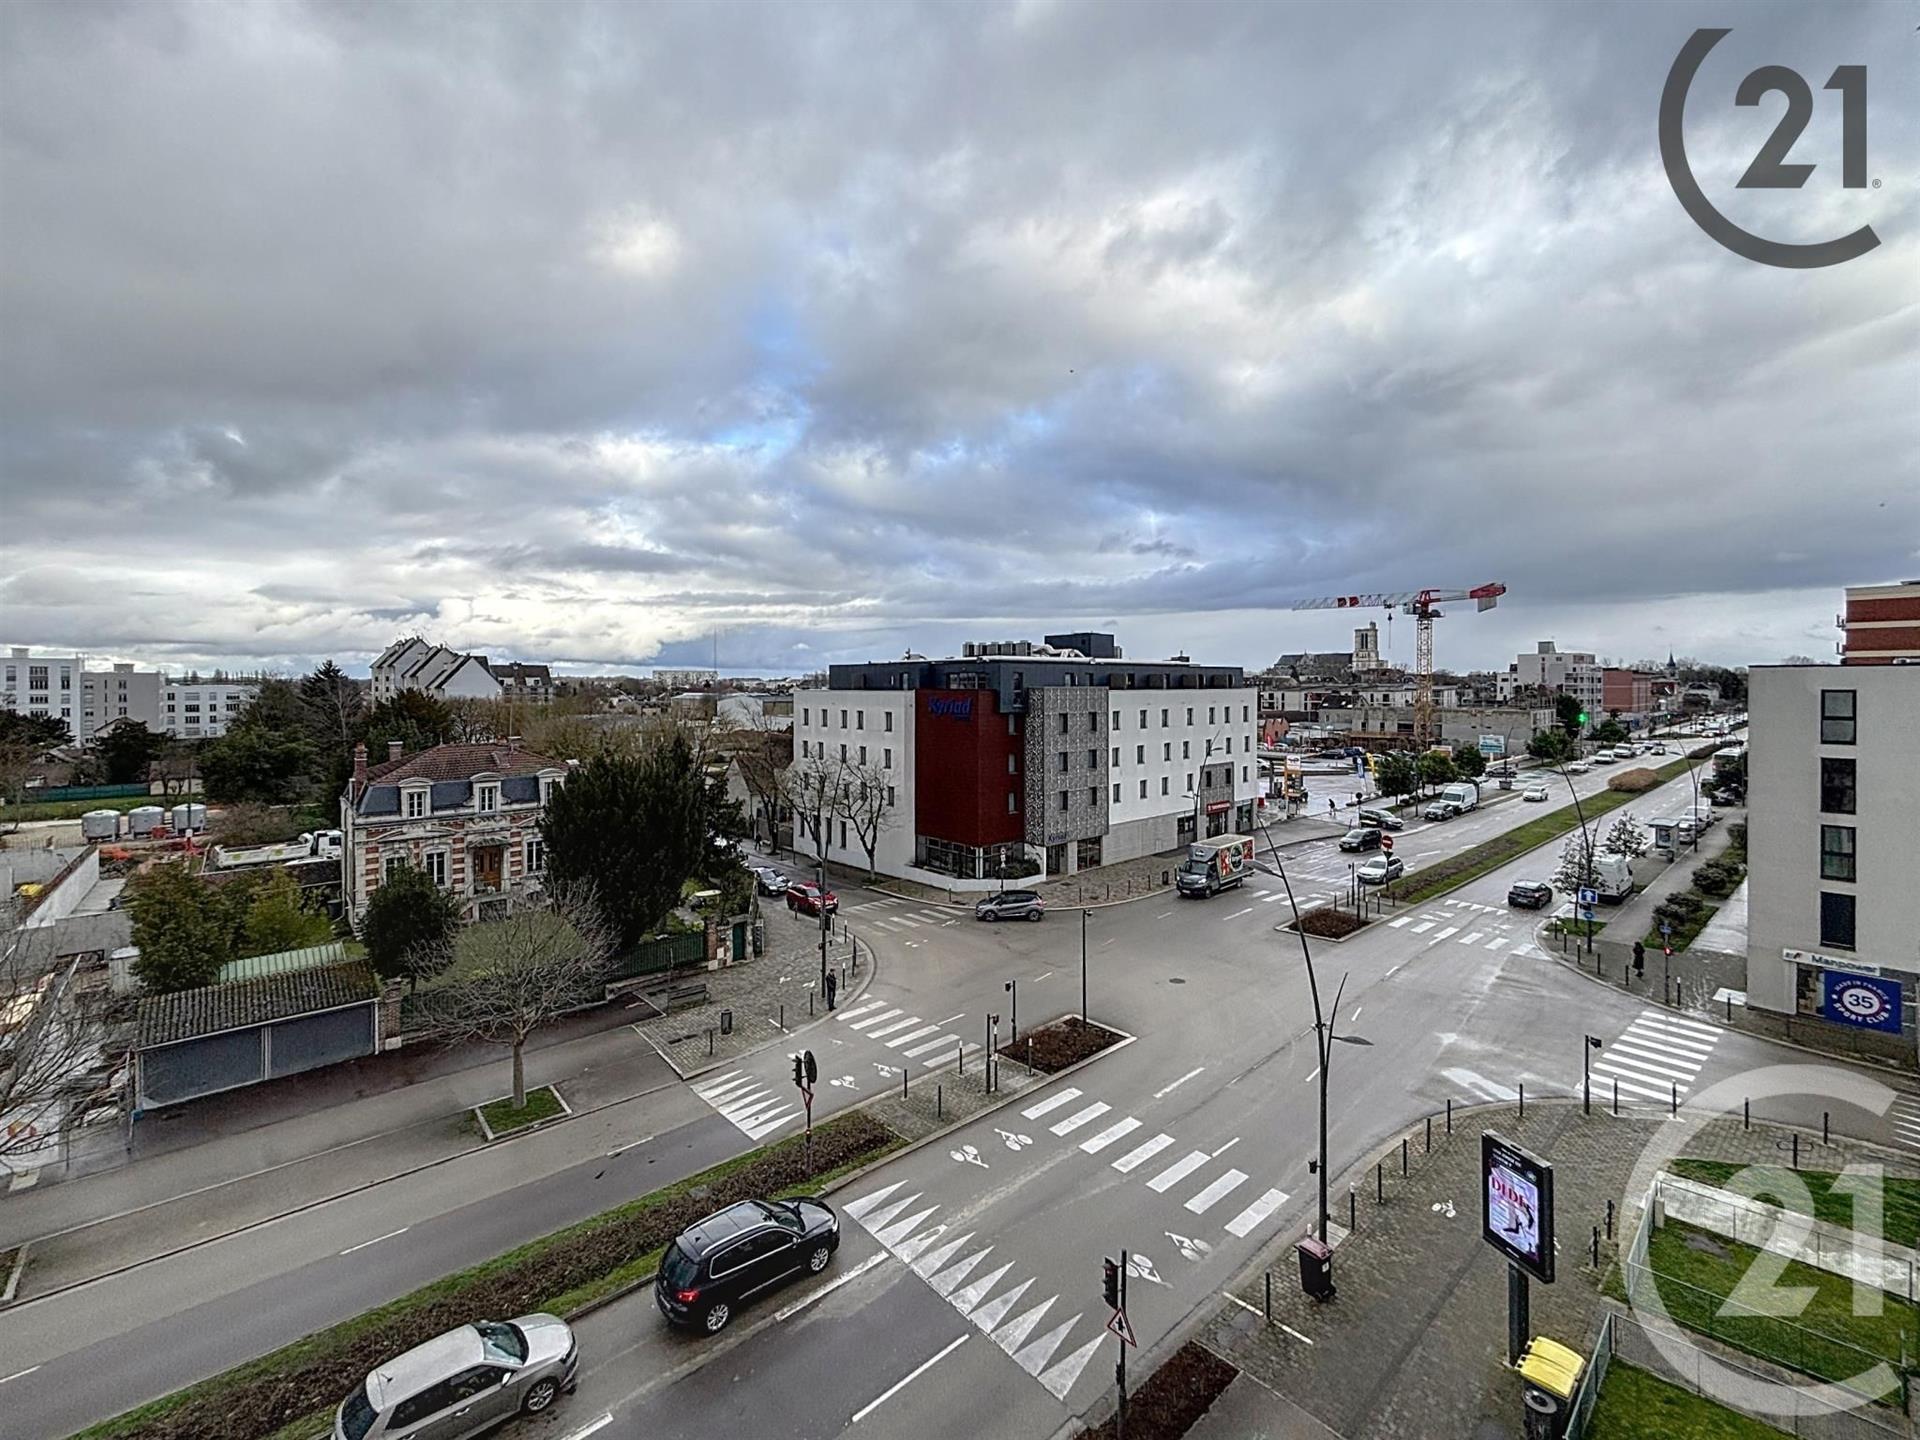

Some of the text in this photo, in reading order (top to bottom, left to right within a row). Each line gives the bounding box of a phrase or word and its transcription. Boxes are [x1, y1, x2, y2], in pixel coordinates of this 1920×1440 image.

[928, 696, 971, 715] Kyriad
[1811, 954, 1878, 973] Manpower
[1848, 993, 1874, 1010] 35
[1865, 1011, 1889, 1024] CLUB
